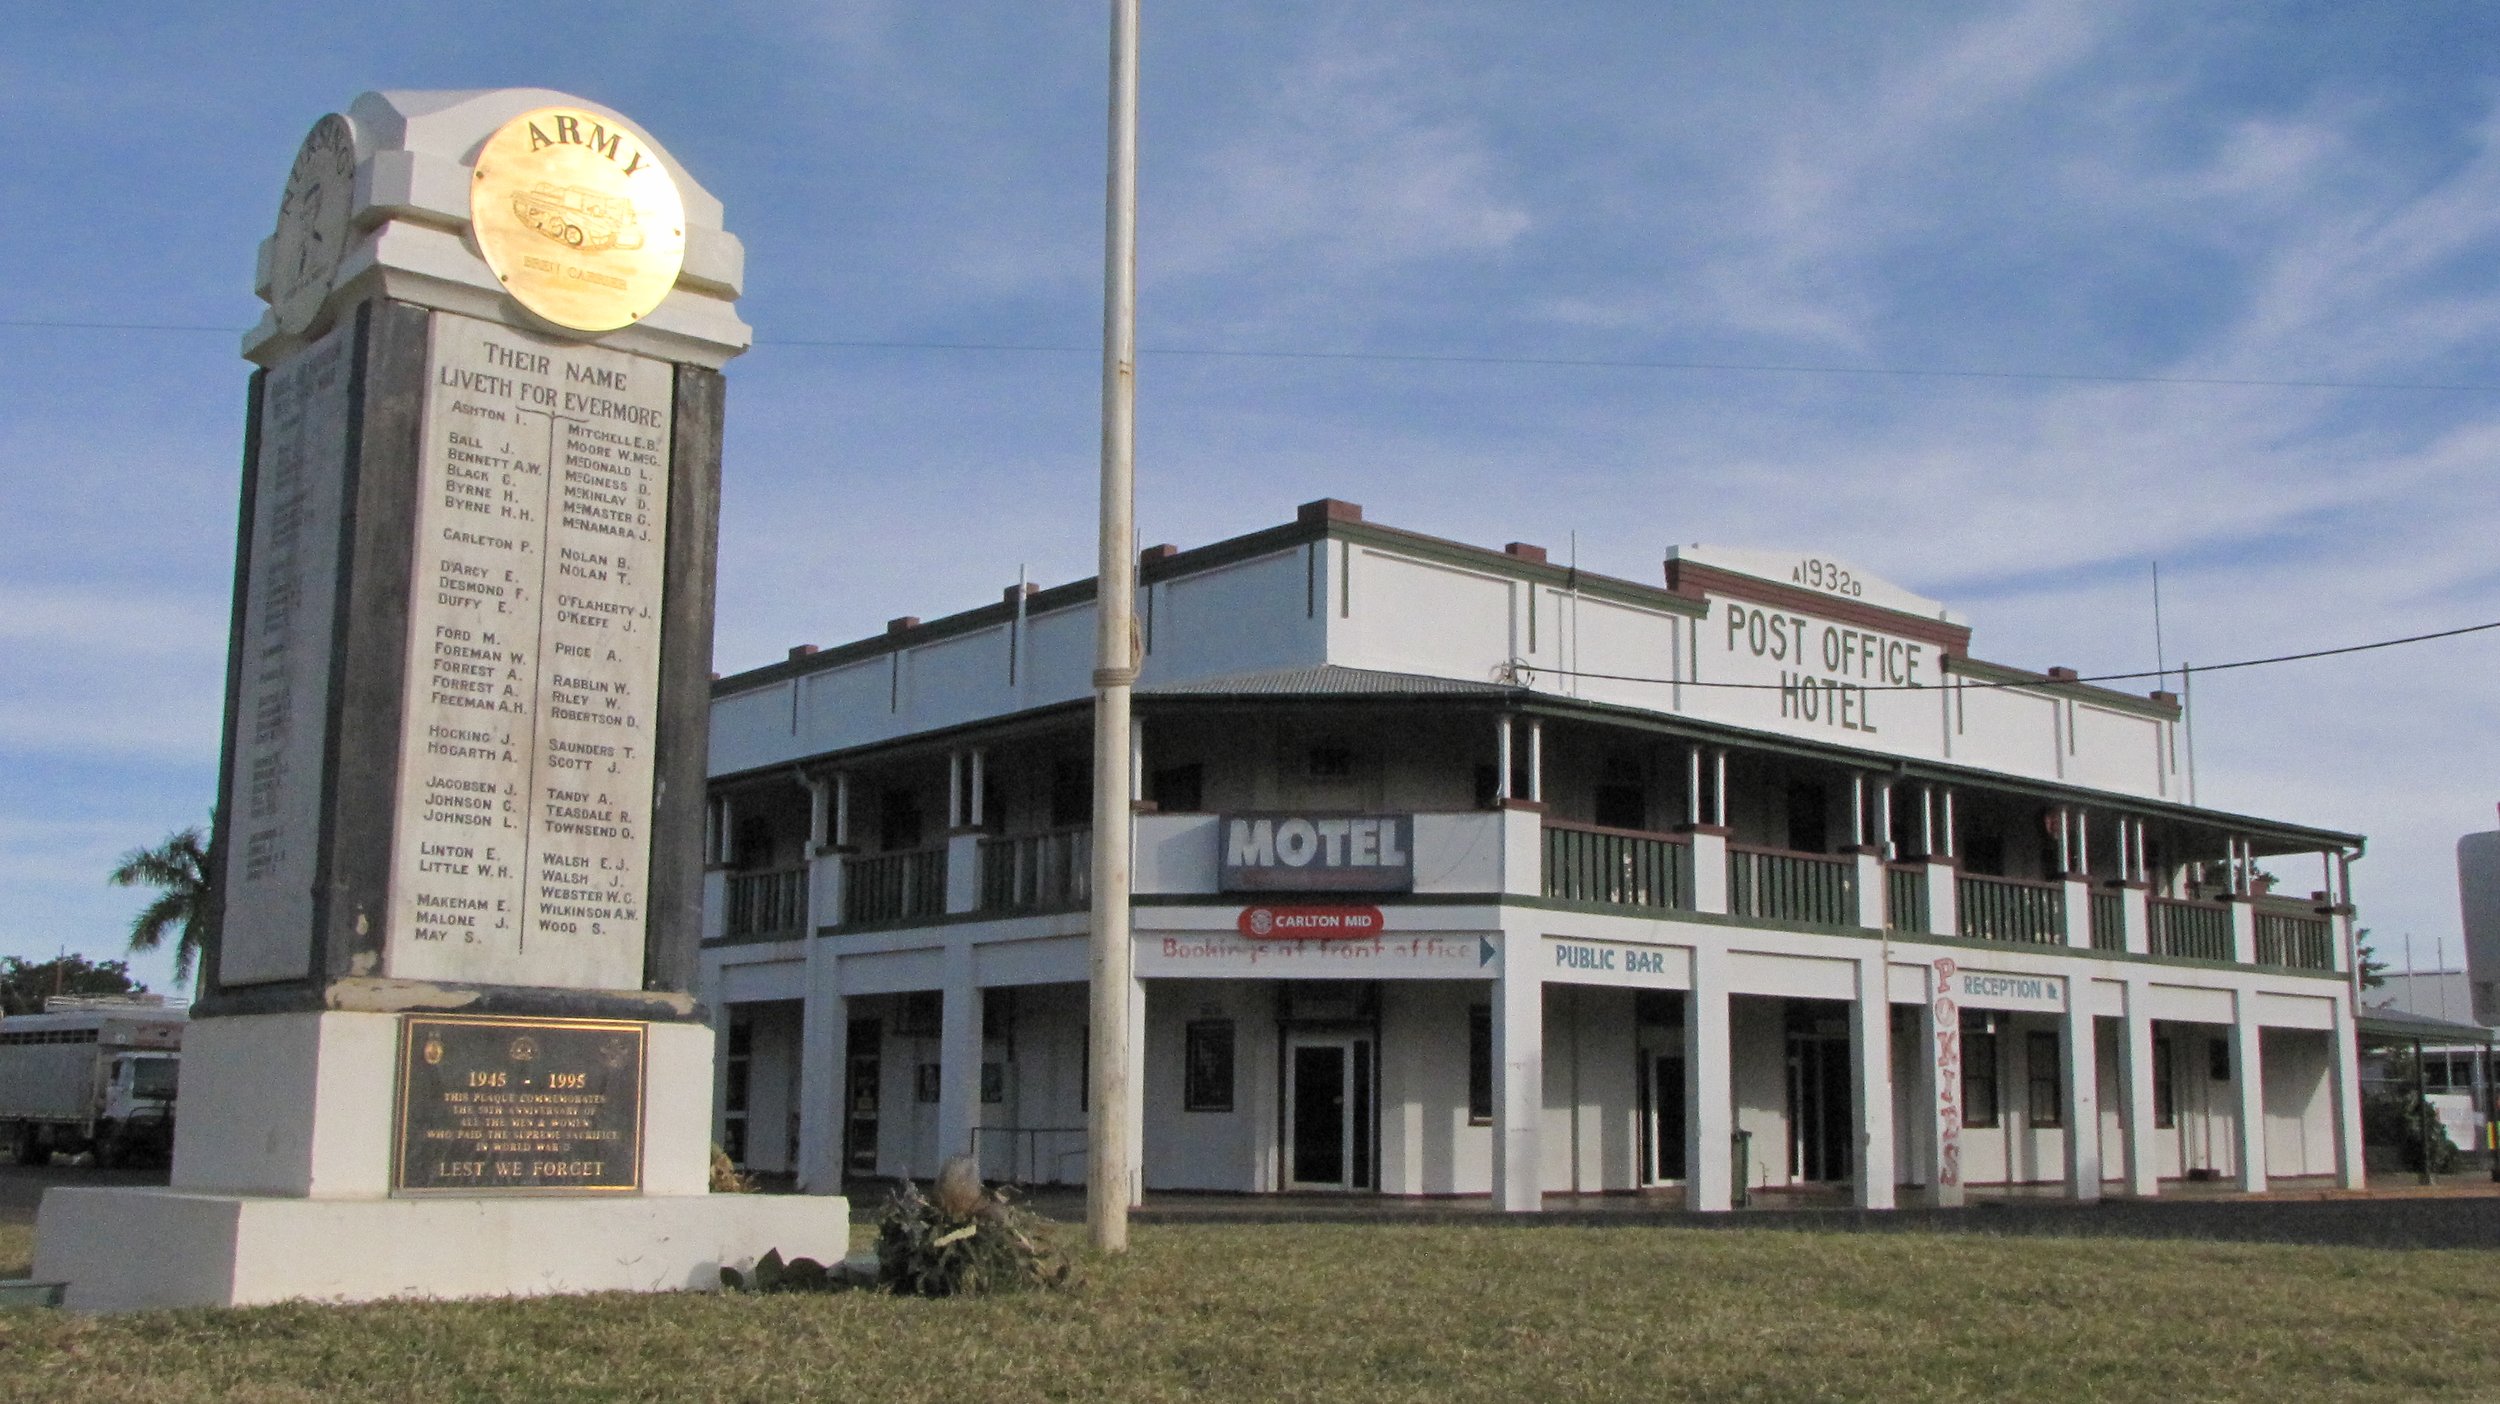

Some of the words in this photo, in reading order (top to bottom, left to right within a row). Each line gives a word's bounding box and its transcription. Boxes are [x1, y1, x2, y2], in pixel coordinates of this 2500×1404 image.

[528, 114, 651, 177] ARMY
[483, 341, 550, 375] THEIR
[566, 361, 627, 392] NAME
[440, 366, 512, 398] LIVETH
[520, 382, 558, 407] FOR
[564, 392, 663, 428] EVERMORE
[452, 400, 505, 420] ASHTON
[449, 432, 483, 448] BALL
[568, 424, 632, 446] MITCHELL
[567, 440, 611, 458] MOORE
[448, 448, 509, 469] BENNETT
[447, 463, 489, 481] BLACK
[446, 480, 492, 498] BYRNE
[445, 495, 491, 514] BYRNE
[443, 528, 513, 550] CARLETON
[561, 547, 608, 565] NOLAN
[440, 560, 489, 578] D'ARCY
[560, 562, 608, 581] NOLAN
[440, 576, 504, 597] DESMOND
[438, 592, 482, 610] DUFFY
[558, 594, 635, 616] O'FLAHERTY
[557, 610, 609, 628] O'KEEFE
[436, 625, 471, 641] FORD
[435, 641, 502, 662] FOREMAN
[555, 641, 591, 658] PRICE
[1727, 603, 1806, 666] POST
[1822, 626, 1923, 688] OFFICE
[433, 658, 495, 677] FORREST
[432, 675, 494, 694] FORREST
[553, 674, 609, 692] RABBLIN
[431, 691, 495, 710] FREEMAN
[552, 690, 589, 706] RILEY
[1780, 670, 1878, 734] HOTEL
[551, 706, 622, 726] ROBERTSON
[429, 724, 490, 743] HOCKING
[428, 741, 496, 760] HOGARTH
[549, 738, 615, 757] SAUNDERS
[548, 754, 593, 771] SCOTT
[426, 776, 496, 794] JACOBSEN
[425, 793, 492, 810] JOHNSON
[546, 788, 590, 802] TANDY
[423, 809, 492, 827] JOHNSON
[546, 804, 613, 822] TEASDALE
[545, 820, 617, 838] TOWNSEND
[421, 841, 474, 859] LINTON
[1226, 818, 1406, 867] MOTEL
[420, 859, 469, 875] LITTLE
[543, 852, 589, 868] WALSH
[542, 869, 588, 885] WALSH
[416, 893, 488, 910] MAKEHAM
[541, 886, 603, 901] WEBSTER
[416, 911, 475, 927] MALONE
[540, 902, 611, 919] WILKINSON
[539, 919, 577, 934] WOOD
[1275, 915, 1339, 927] CARLTON
[1344, 915, 1372, 927] MID
[415, 927, 448, 941] MAY
[1556, 944, 1615, 970] PUBLIC
[1625, 950, 1665, 973] BAR
[1964, 975, 2041, 999] RECEPTION
[468, 1071, 507, 1087] 1945
[549, 1072, 586, 1089] 1995
[1933, 956, 1960, 1186] POKIES
[444, 1092, 469, 1102] THIS
[473, 1093, 515, 1104] PLAQUE
[520, 1093, 606, 1104] COMMEMORATES
[453, 1105, 472, 1115] THE
[584, 1107, 597, 1116] OF
[485, 1118, 505, 1127] THE
[512, 1118, 533, 1127] MEN
[551, 1119, 591, 1128] WOMEN
[426, 1129, 451, 1139] WHO
[457, 1130, 482, 1139] PAID
[488, 1130, 506, 1139] THE
[513, 1130, 560, 1140] SUPREME
[566, 1130, 618, 1140] SACRIFICE
[476, 1142, 489, 1151] IN
[494, 1142, 531, 1152] WORLD
[536, 1143, 559, 1152] WAR
[439, 1161, 486, 1177] LEST
[495, 1161, 523, 1176] WE
[532, 1161, 606, 1177] FORGET
